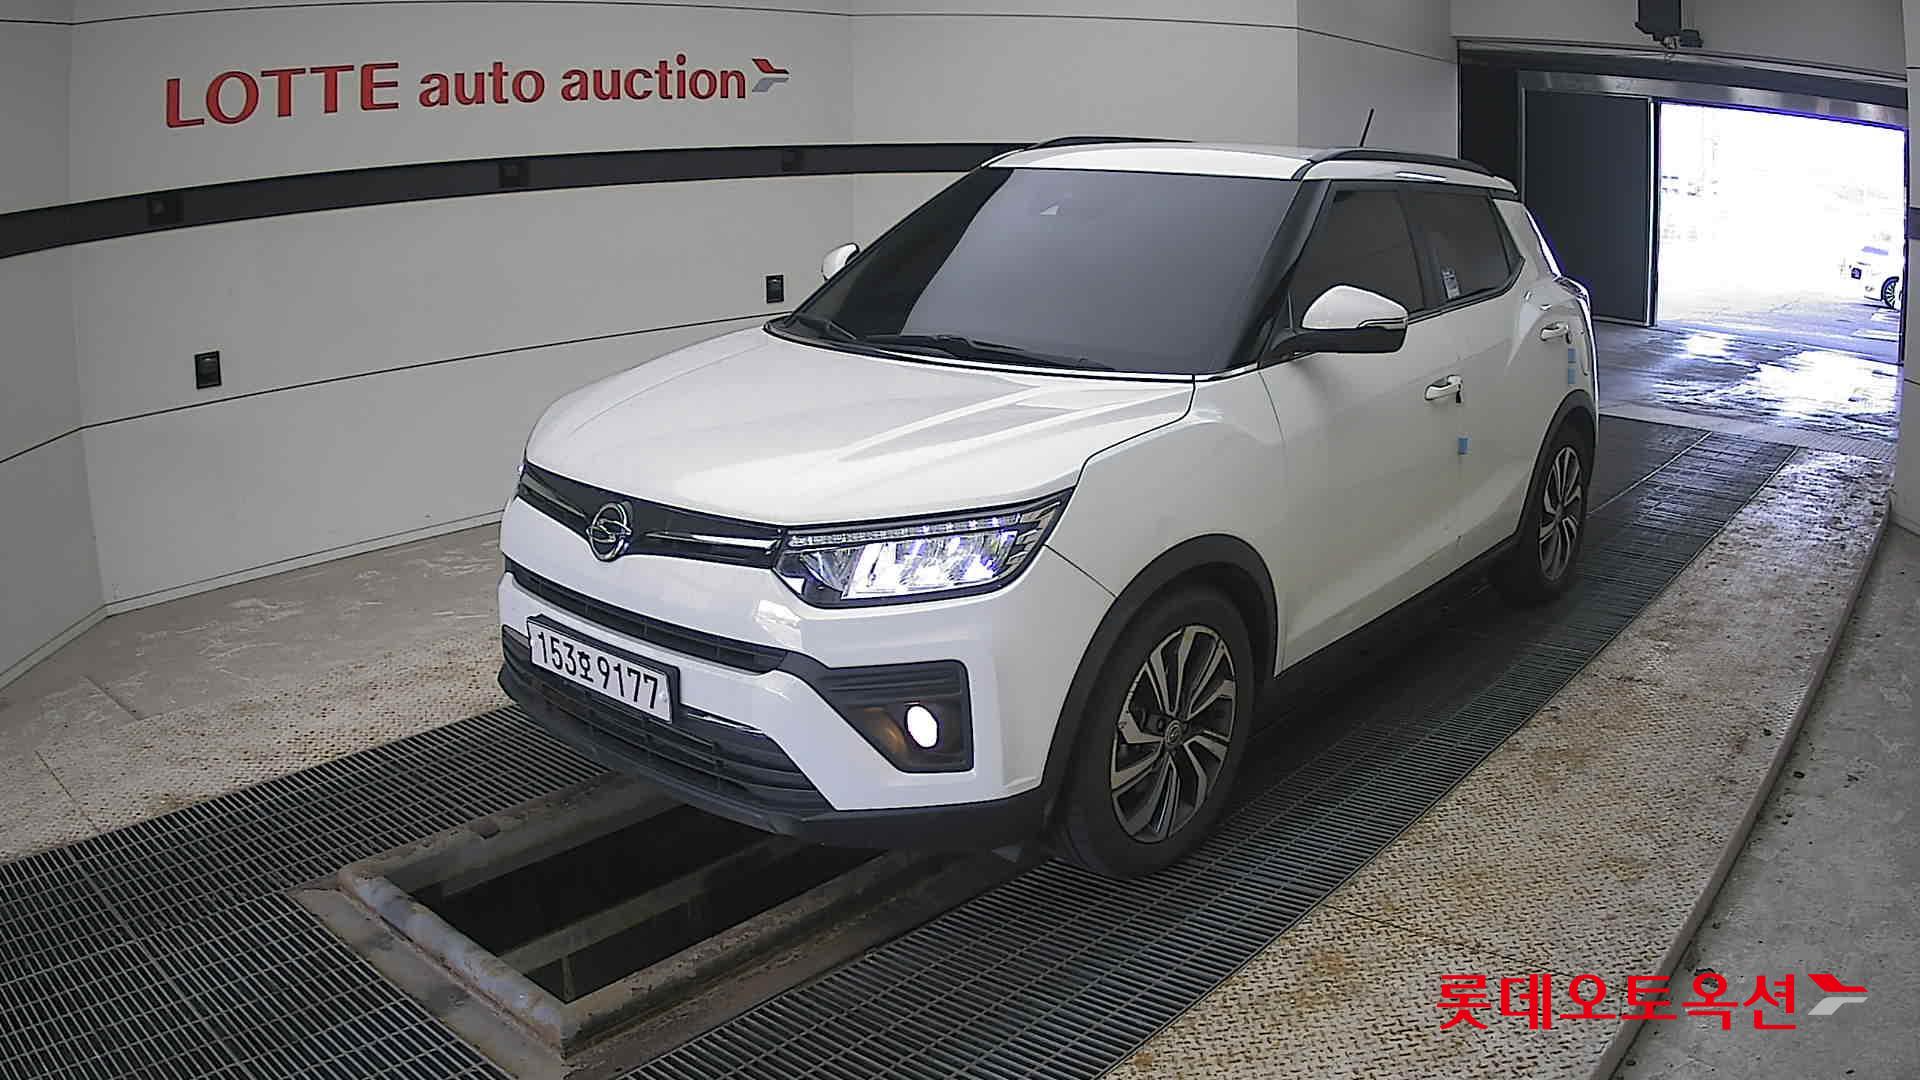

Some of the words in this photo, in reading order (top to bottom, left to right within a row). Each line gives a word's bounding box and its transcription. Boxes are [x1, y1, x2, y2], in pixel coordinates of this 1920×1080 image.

[165, 62, 399, 129] LOTTE
[418, 60, 545, 107] auto
[561, 54, 747, 101] auction
